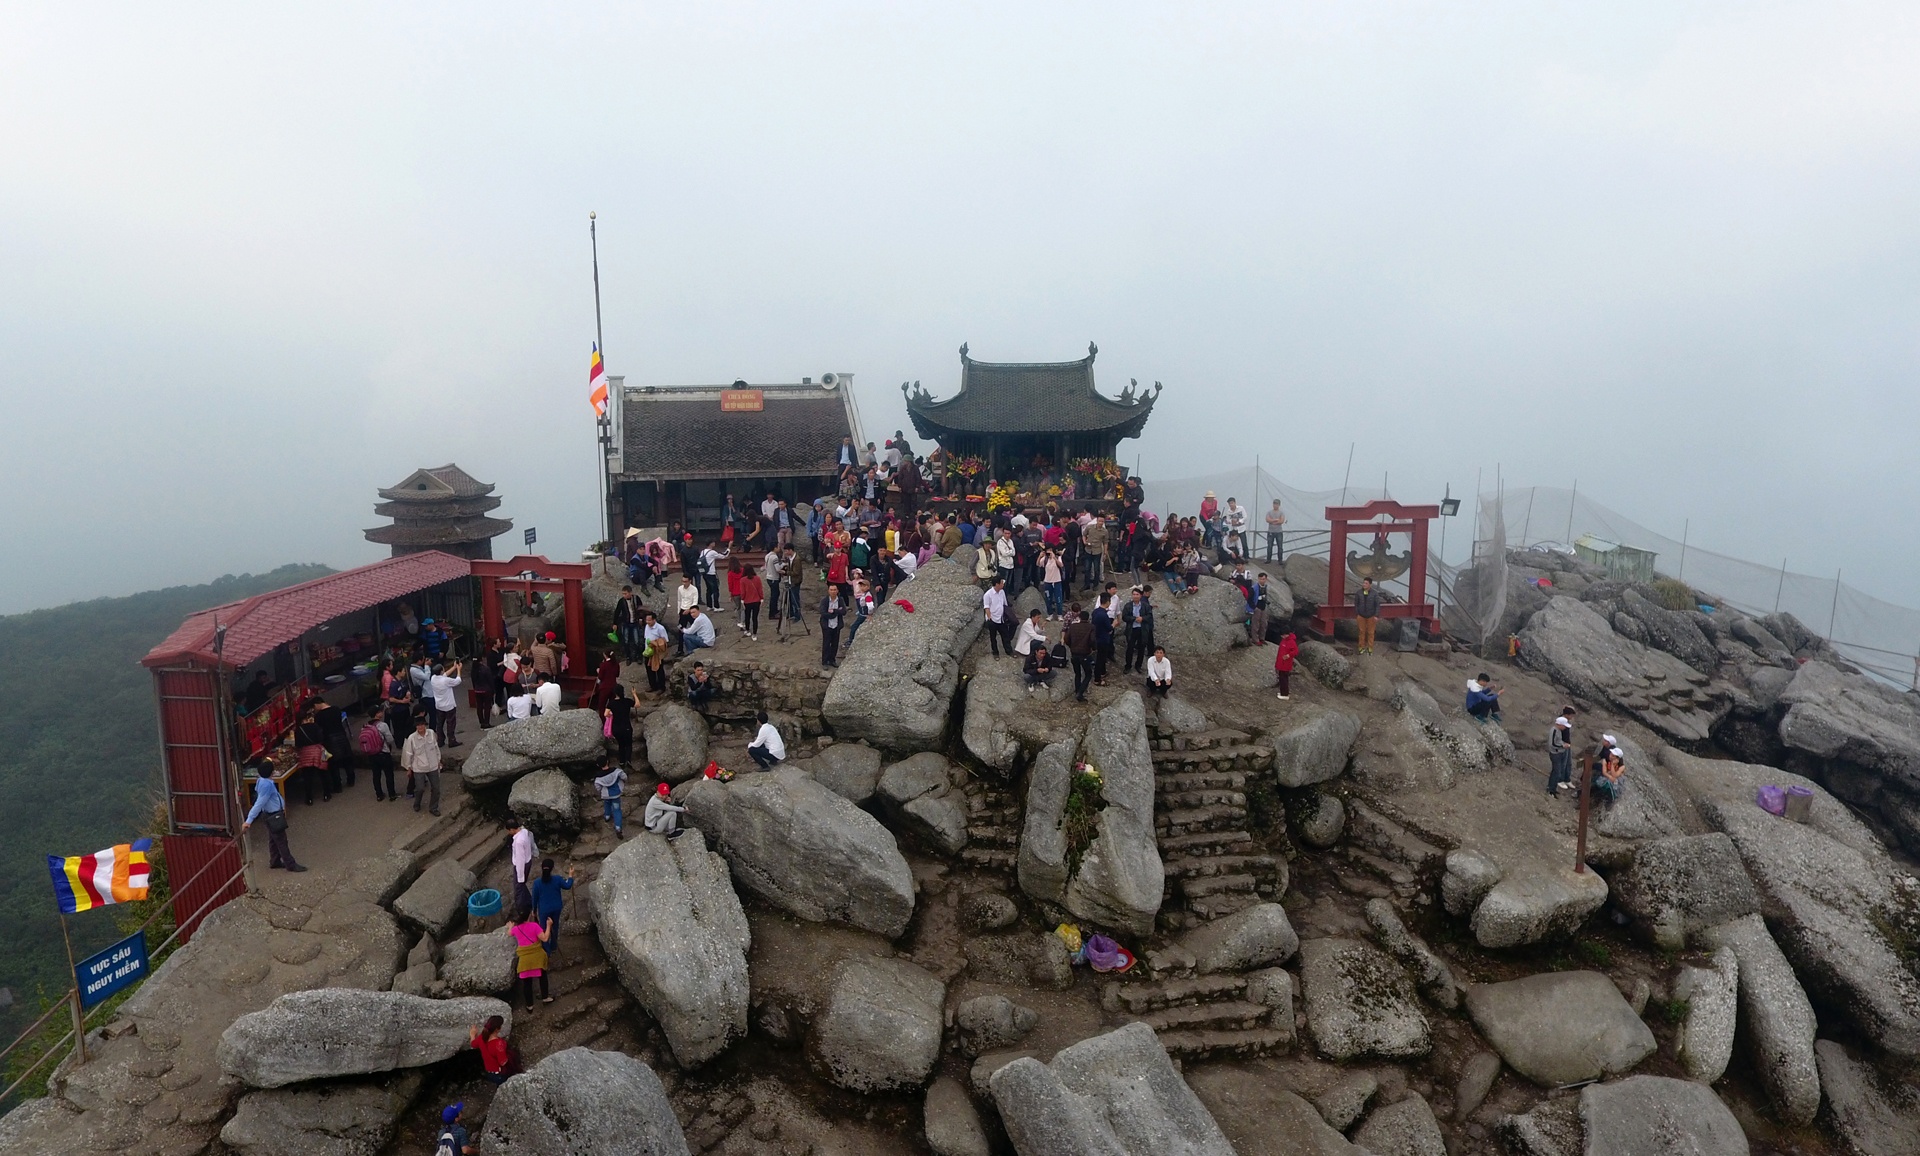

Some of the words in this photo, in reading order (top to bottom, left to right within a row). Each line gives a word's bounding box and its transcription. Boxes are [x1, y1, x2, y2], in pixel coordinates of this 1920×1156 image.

[90, 959, 110, 975] VỰC
[112, 947, 131, 963] SÂU
[87, 973, 113, 994] NGUY
[115, 960, 139, 979] HIỂM
